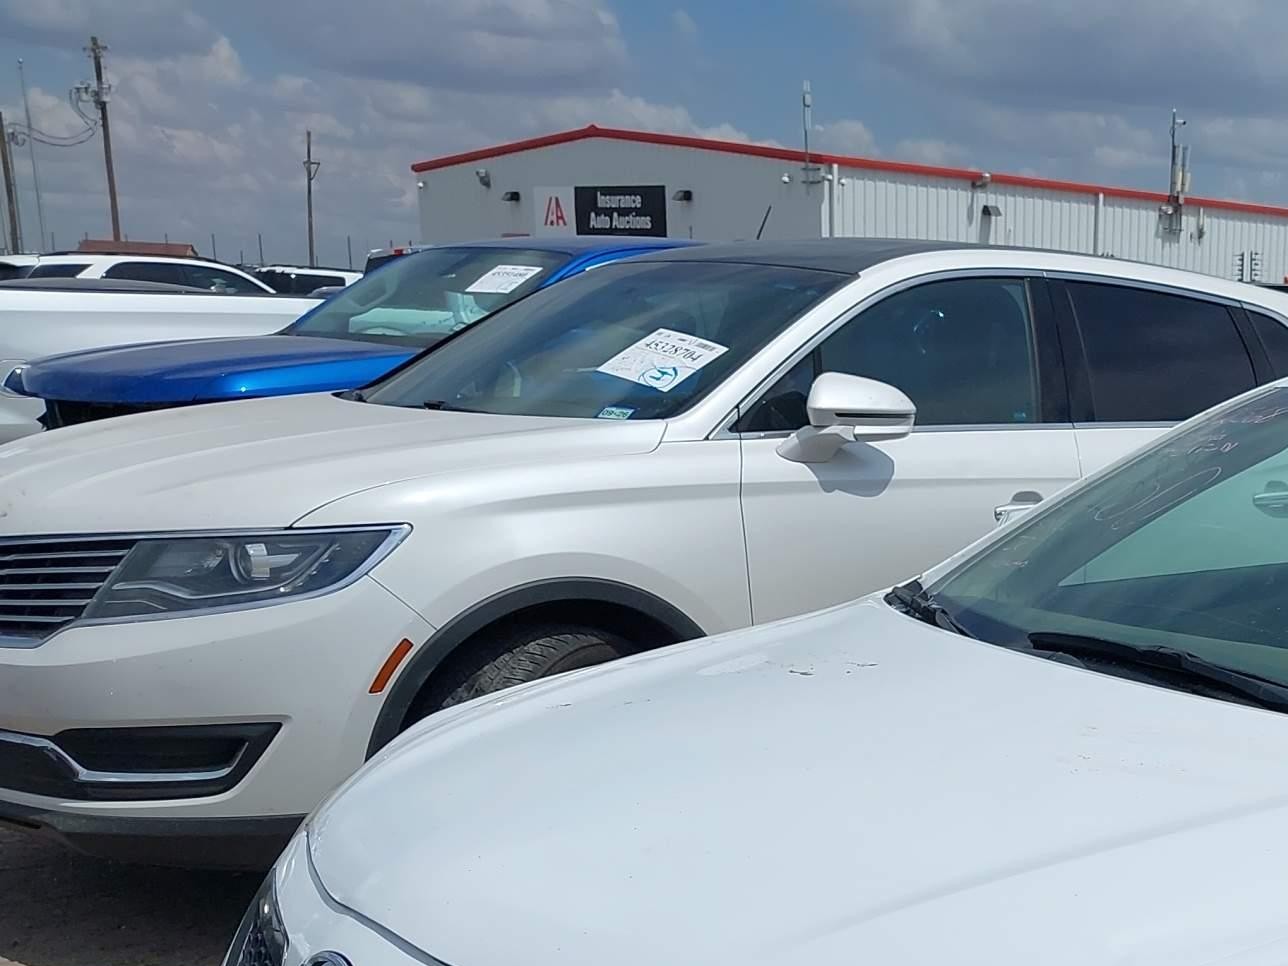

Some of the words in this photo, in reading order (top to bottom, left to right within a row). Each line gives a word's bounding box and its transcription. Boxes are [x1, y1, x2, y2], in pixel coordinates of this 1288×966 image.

[597, 191, 642, 208] Insurance
[589, 212, 610, 229] Auto
[612, 211, 652, 230] Auctions
[645, 340, 704, 362] 45328704
